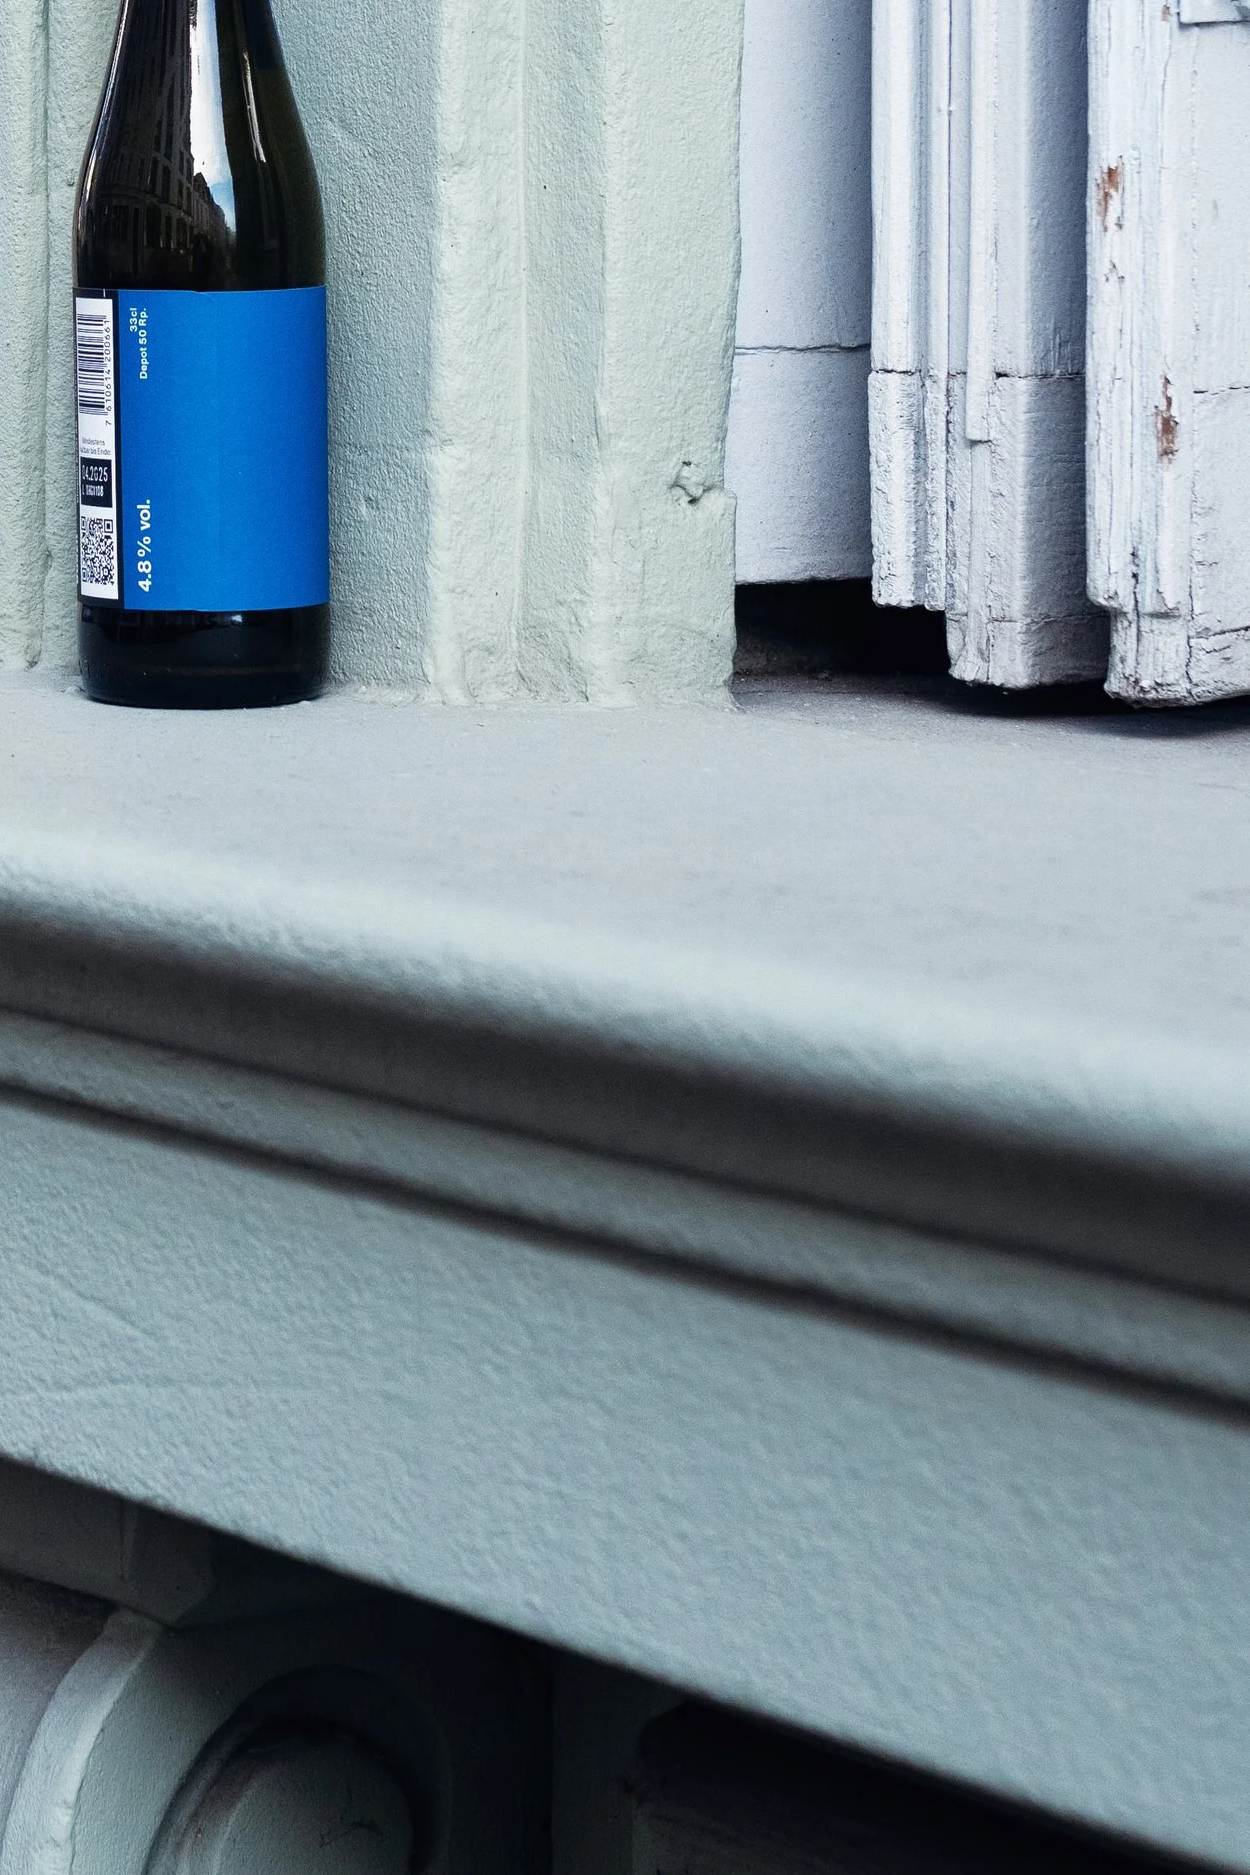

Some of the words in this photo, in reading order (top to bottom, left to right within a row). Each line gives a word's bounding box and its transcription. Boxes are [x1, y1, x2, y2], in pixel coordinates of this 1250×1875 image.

[130, 307, 138, 332] 33cl
[138, 308, 149, 326] Rp.
[138, 329, 147, 344] 50
[139, 348, 149, 380] Depot
[137, 499, 151, 531] vol.
